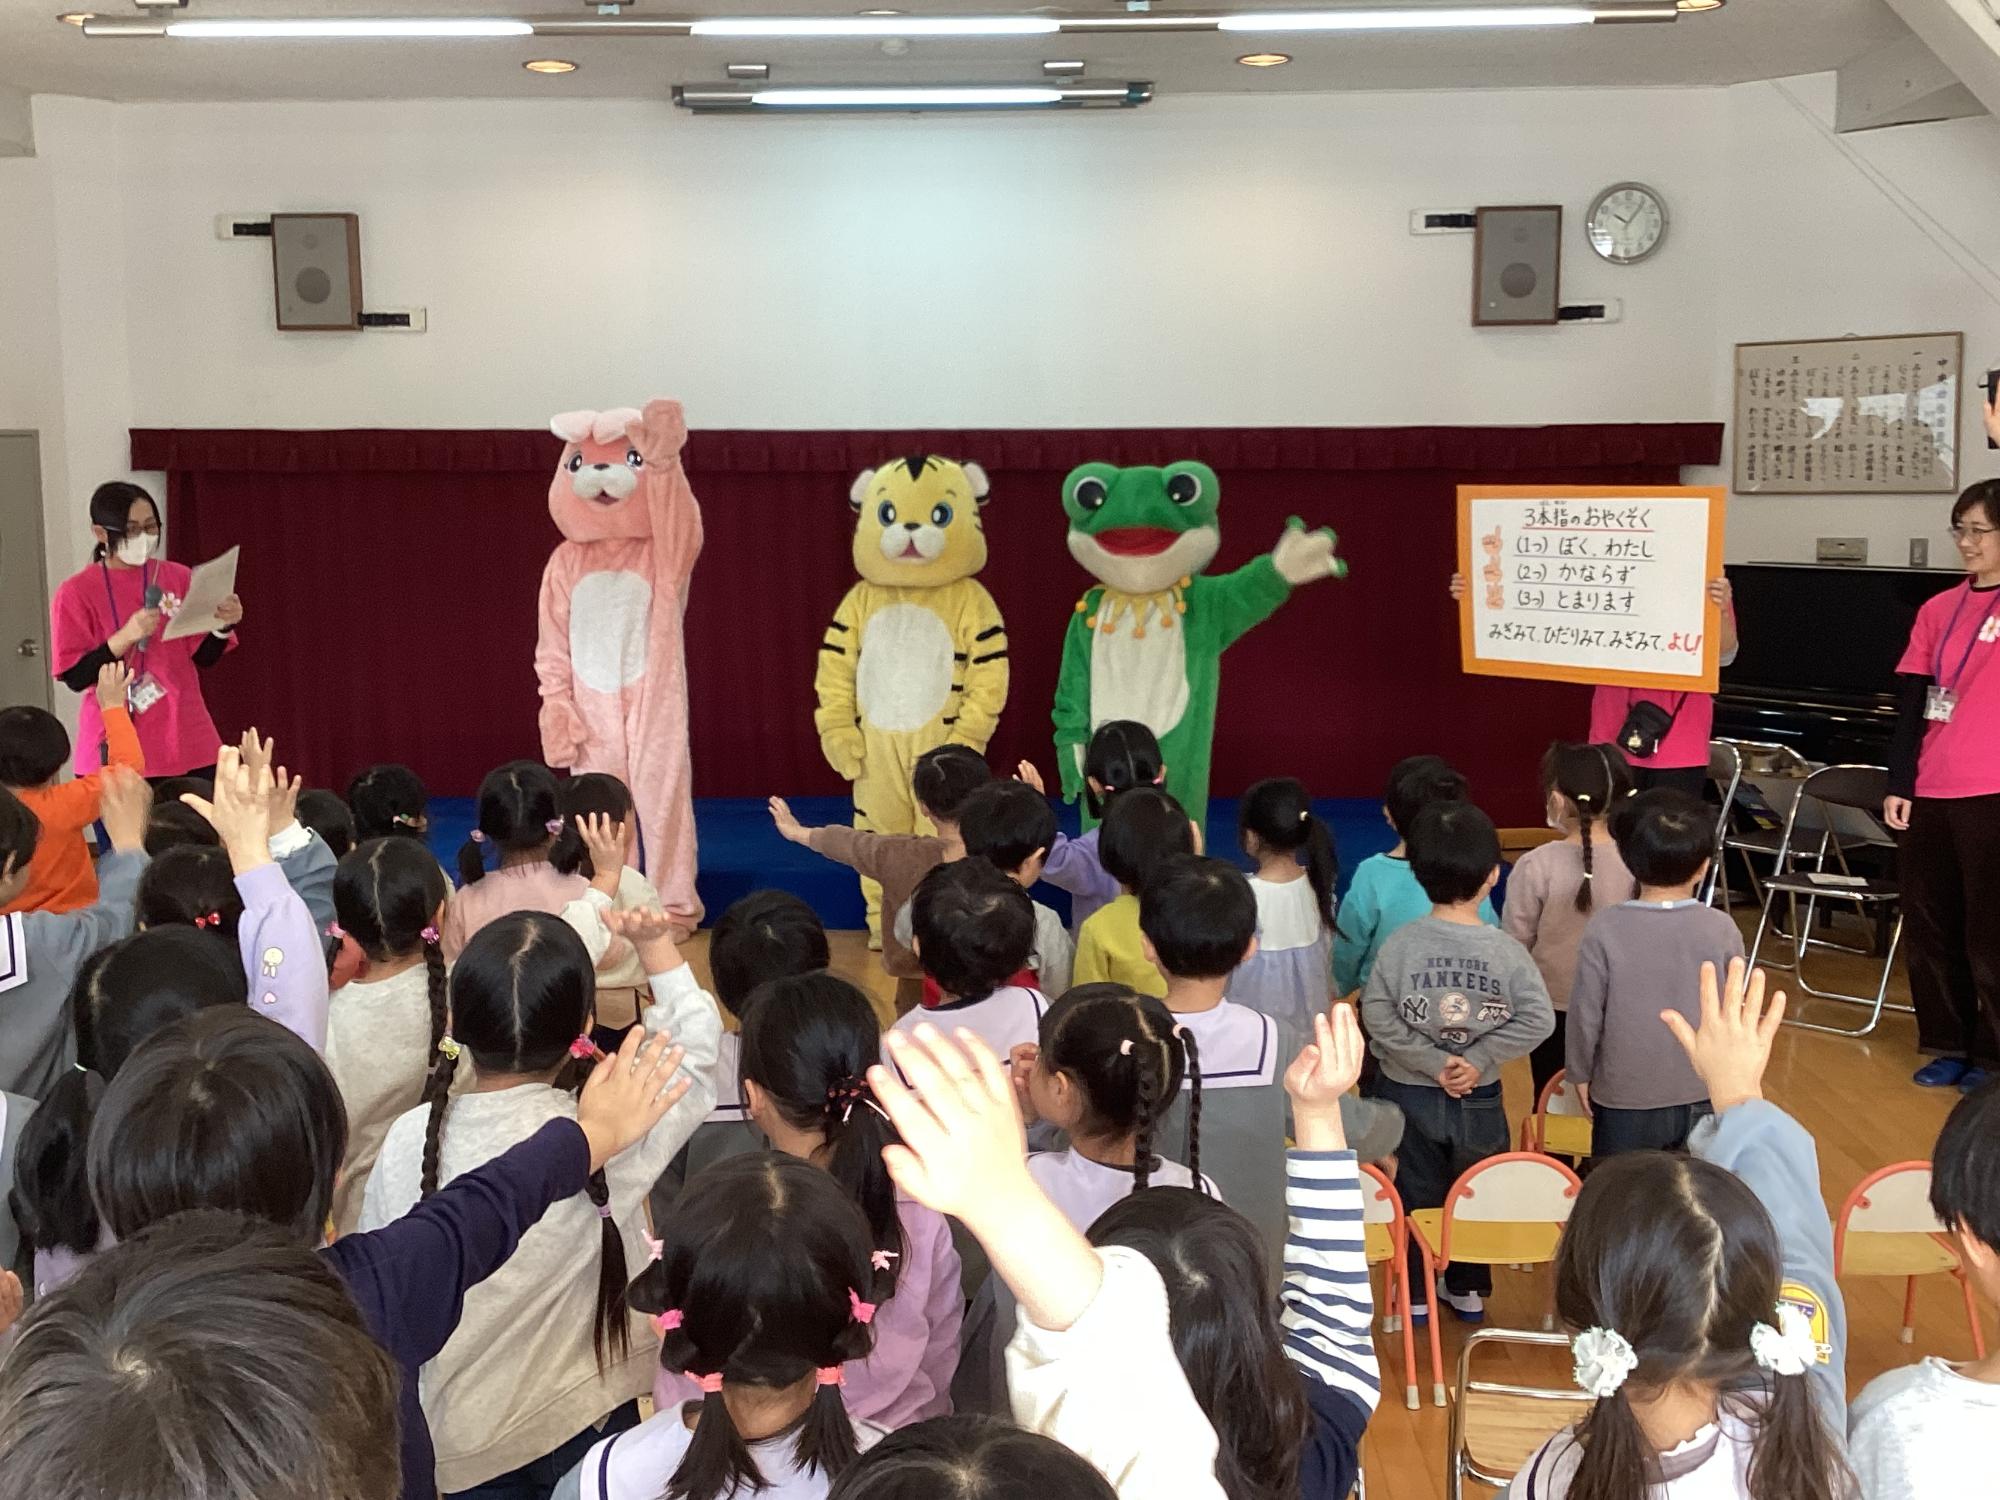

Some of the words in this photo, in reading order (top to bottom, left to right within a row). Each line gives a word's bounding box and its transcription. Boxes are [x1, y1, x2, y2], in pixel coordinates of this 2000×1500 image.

[1524, 506, 1651, 528] 3本指のおやくそく
[1427, 957, 1453, 968] NEW
[1458, 958, 1489, 972] YORK
[1410, 971, 1501, 996] YANKEES
